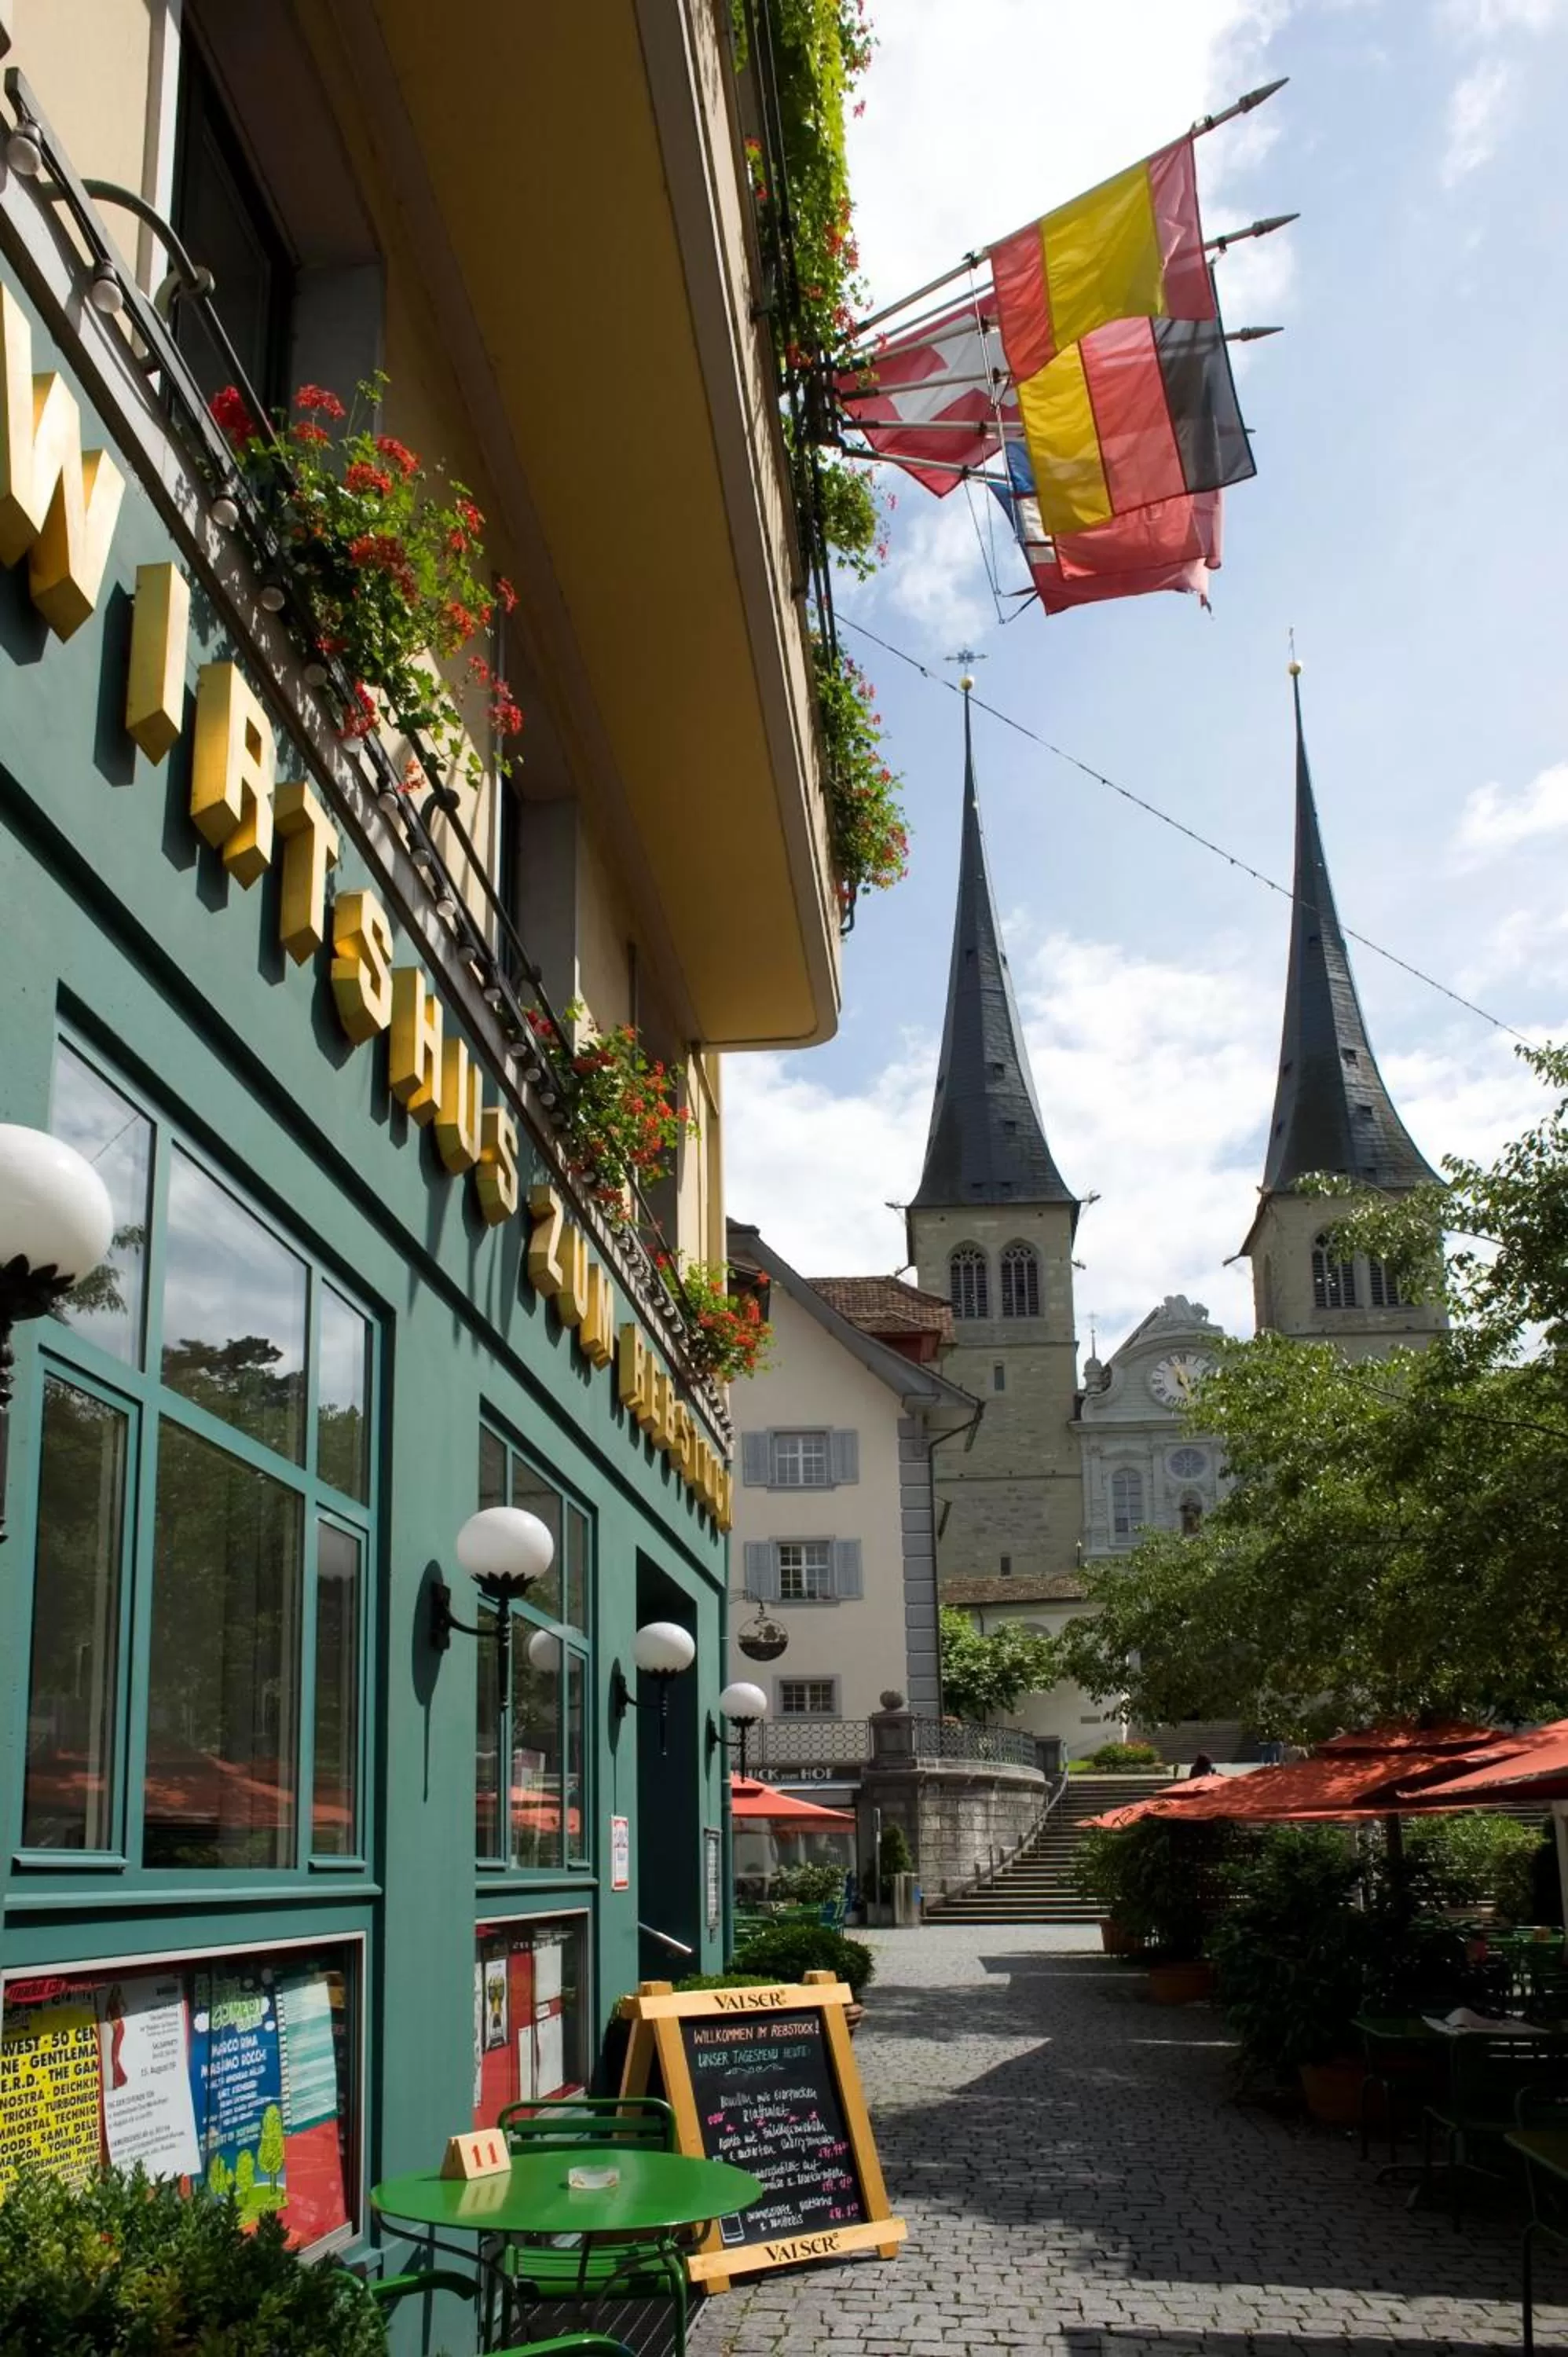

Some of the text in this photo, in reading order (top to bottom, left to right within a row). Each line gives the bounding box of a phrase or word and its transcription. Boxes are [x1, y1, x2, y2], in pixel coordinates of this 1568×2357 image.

[0, 281, 733, 1533] WIRTSHUS ZUM REBSTOCK
[2, 2036, 40, 2058] WEST
[52, 2030, 69, 2048] 50
[693, 2026, 754, 2044] WILLKOMMEN
[757, 2025, 768, 2039] IM
[1, 2044, 97, 2075] NE GENTLEMA
[698, 2051, 729, 2068] UNSER
[1, 2073, 39, 2094] E.R.D.
[49, 2066, 69, 2082] THE
[0, 2089, 45, 2110] NOSTRA
[3, 2106, 38, 2124] TRICKS
[1, 2136, 31, 2155] OODS
[41, 2127, 70, 2144] SAMY
[49, 2135, 82, 2152] YOUNG
[471, 2142, 498, 2168] 11
